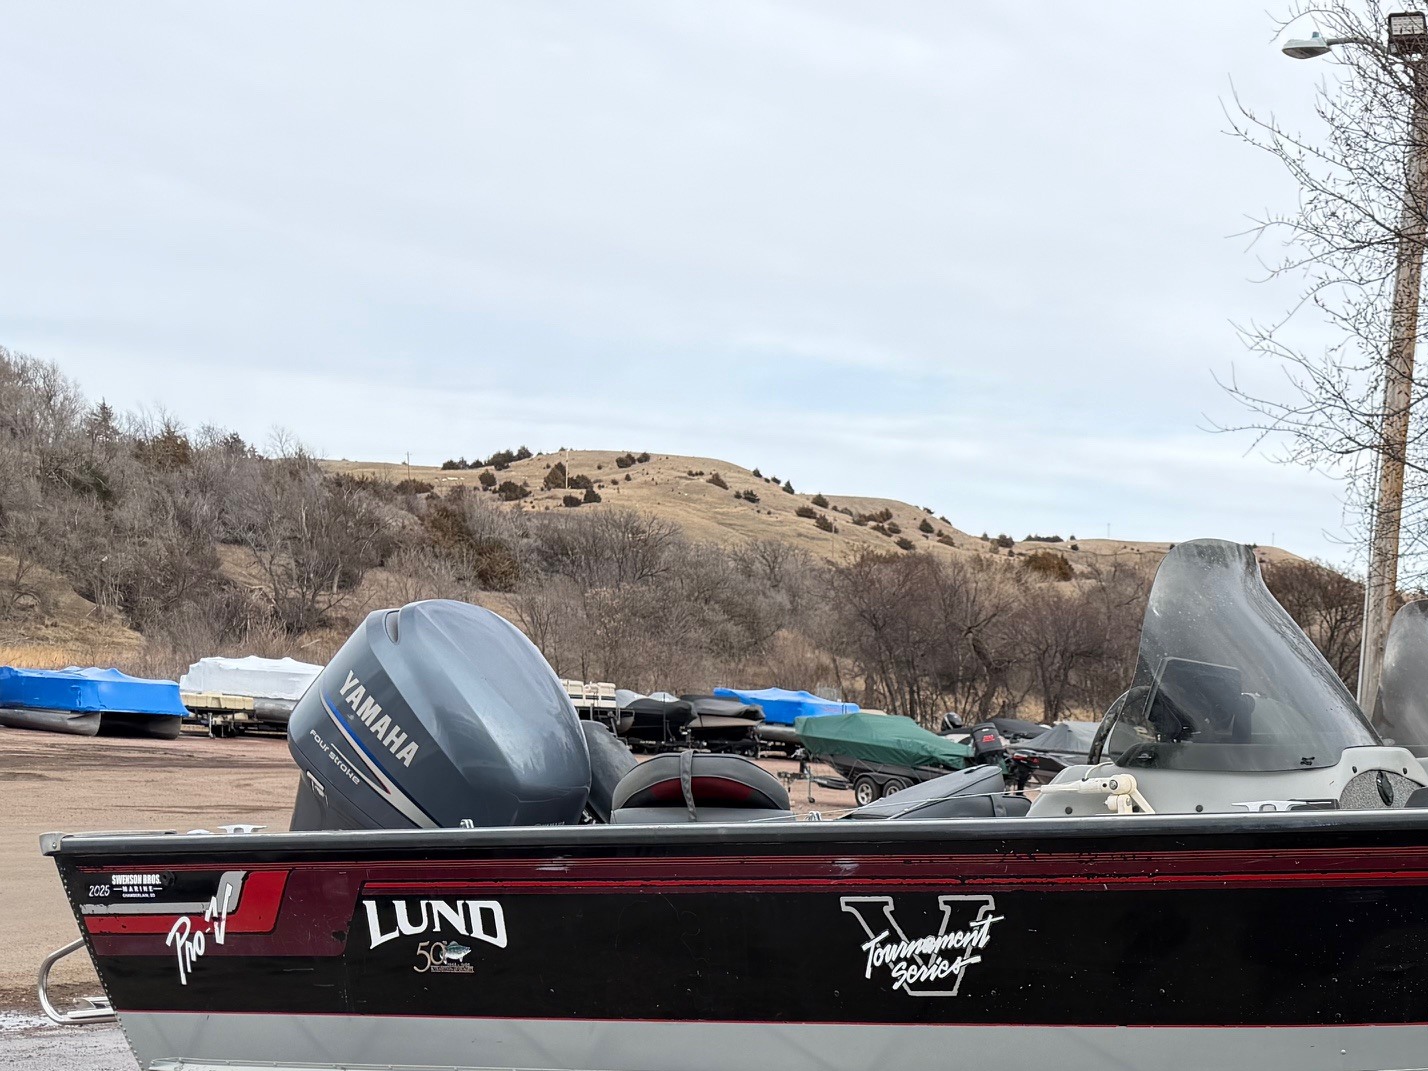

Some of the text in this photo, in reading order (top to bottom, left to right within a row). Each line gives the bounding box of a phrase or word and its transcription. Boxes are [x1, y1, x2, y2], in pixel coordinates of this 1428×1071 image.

[339, 670, 419, 768] YAMAHA
[88, 885, 110, 897] 2025
[111, 874, 162, 885] SWENSON BROS.
[165, 882, 233, 986] Pro-V
[362, 900, 508, 950] LUND
[860, 914, 1005, 979] Tournament
[891, 955, 982, 991] Series
